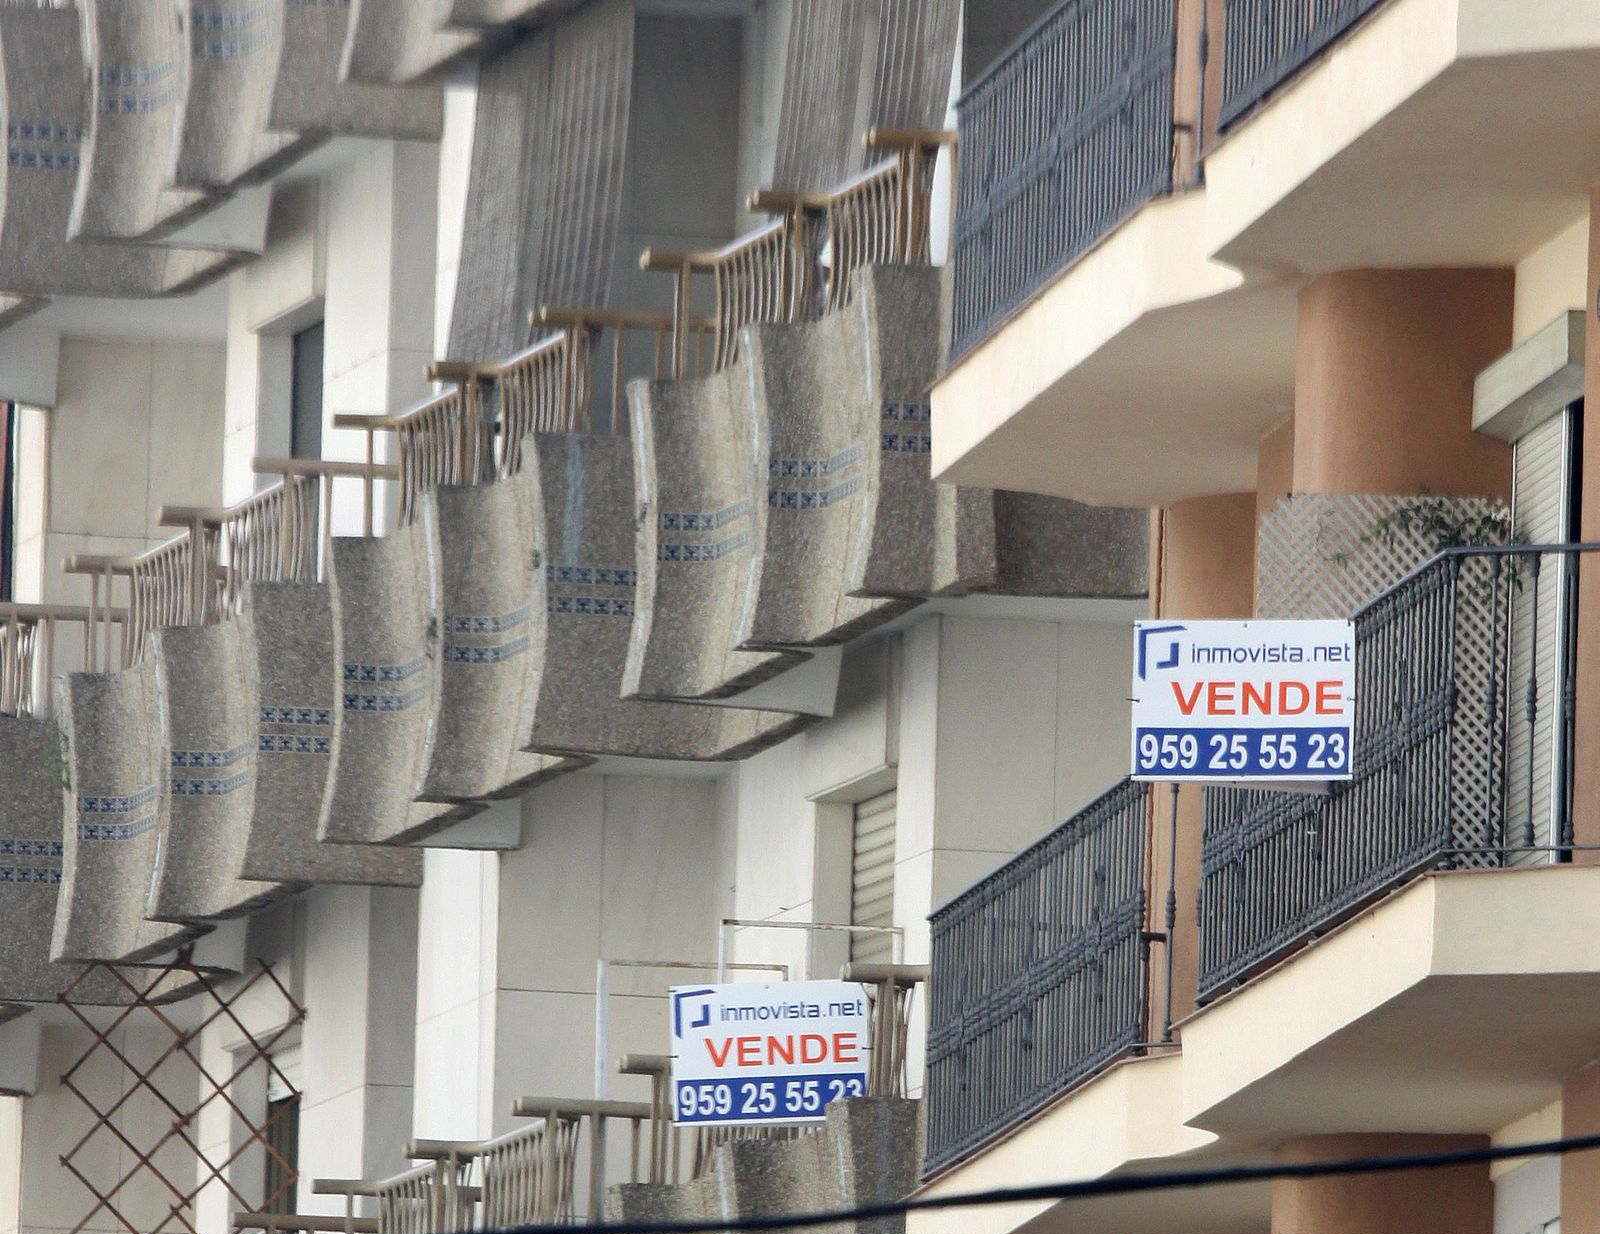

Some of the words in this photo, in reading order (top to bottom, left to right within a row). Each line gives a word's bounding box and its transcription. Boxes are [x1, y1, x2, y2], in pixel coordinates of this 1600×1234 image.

[1191, 643, 1350, 663] inmovista.net
[1171, 681, 1343, 715] VENDE
[1139, 734, 1198, 769] 959
[1208, 734, 1248, 769] 25
[1259, 734, 1297, 769] 55
[1307, 733, 1345, 769] 23
[720, 999, 863, 1021] inmovista.net
[703, 1032, 859, 1068] VENDE
[680, 1084, 732, 1116] 959
[741, 1082, 776, 1114] 25
[785, 1080, 820, 1112] 55
